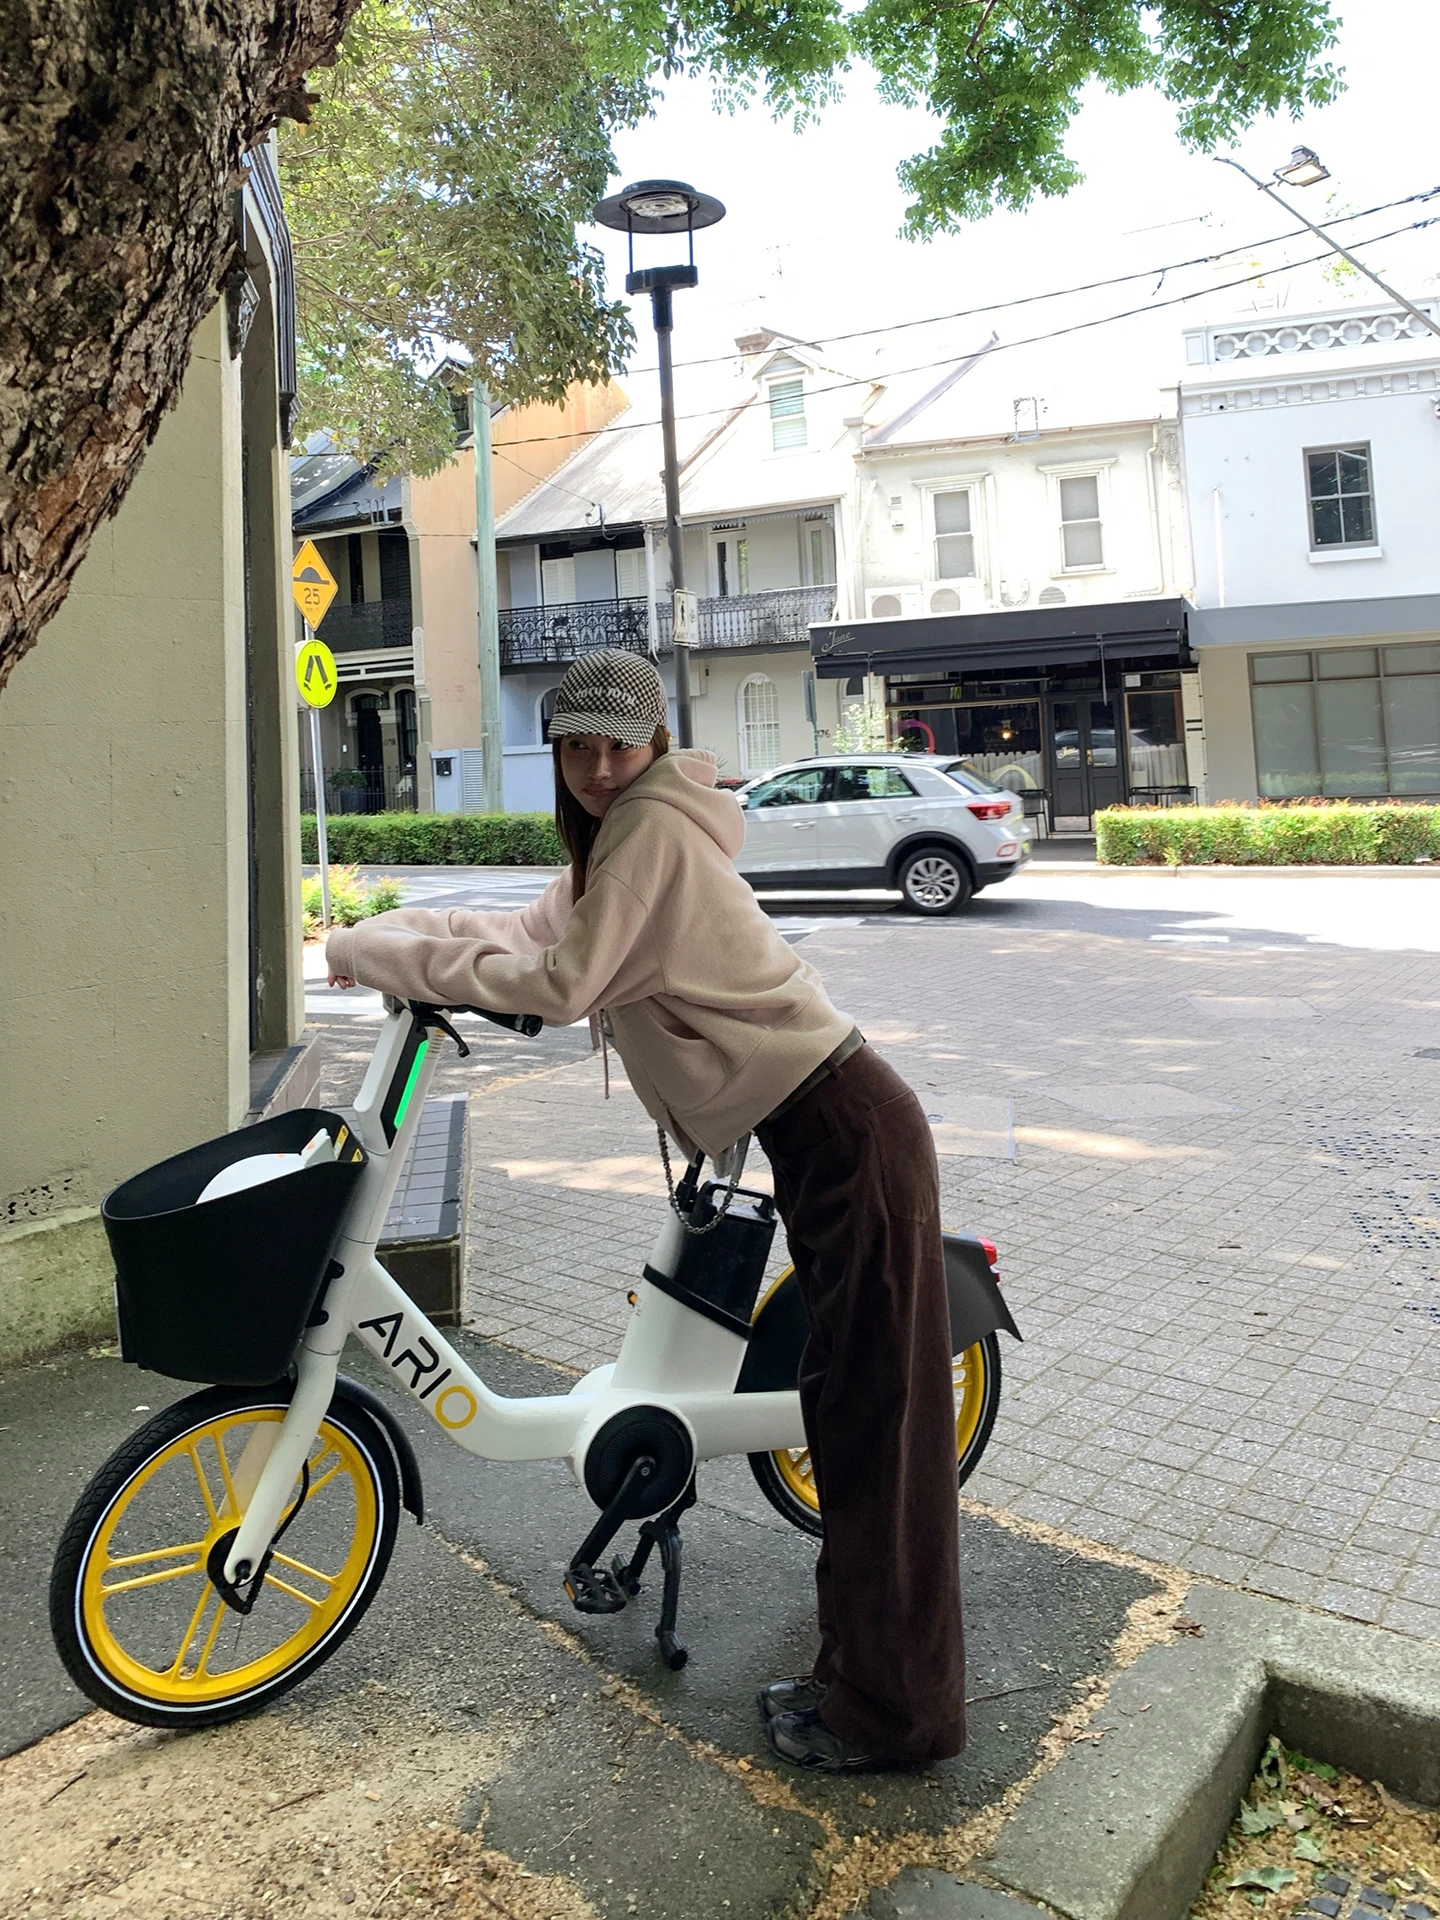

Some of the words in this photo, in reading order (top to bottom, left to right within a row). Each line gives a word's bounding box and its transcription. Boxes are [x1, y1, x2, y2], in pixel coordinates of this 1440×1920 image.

[304, 587, 320, 605] 25
[821, 629, 855, 652] Jane
[358, 1312, 477, 1430] ARIO
